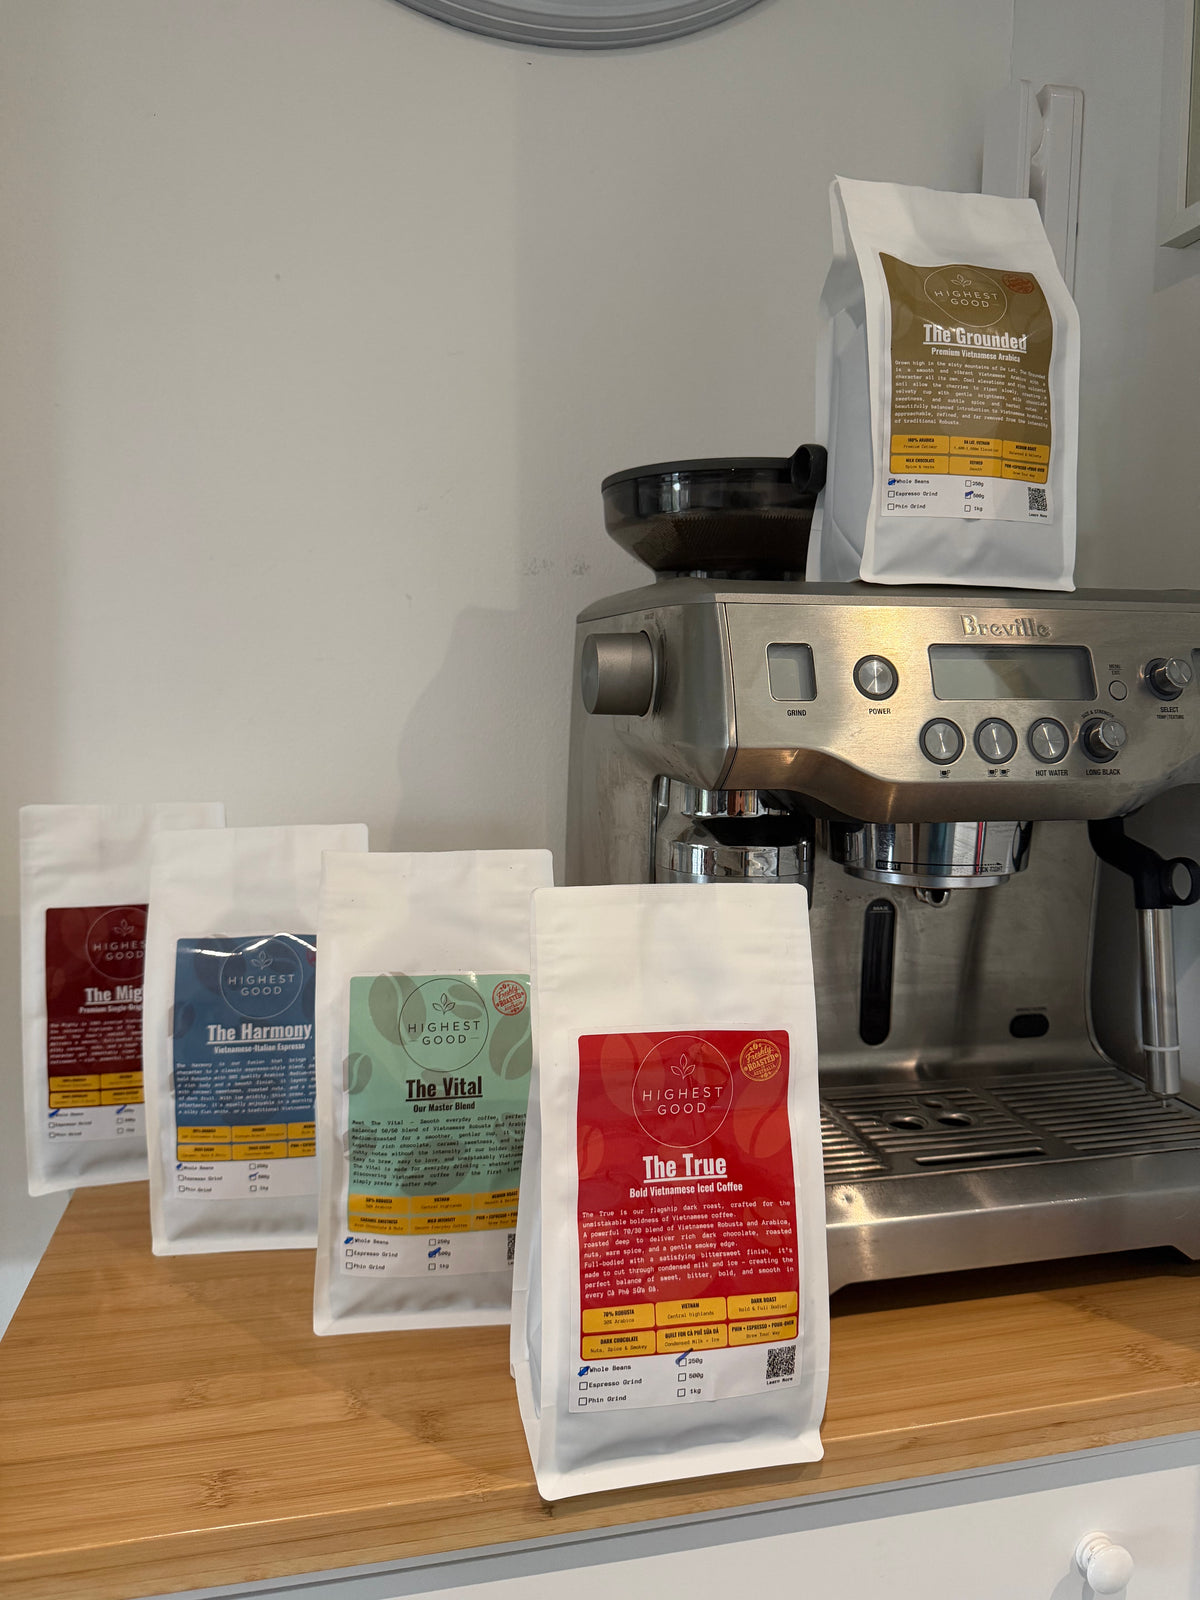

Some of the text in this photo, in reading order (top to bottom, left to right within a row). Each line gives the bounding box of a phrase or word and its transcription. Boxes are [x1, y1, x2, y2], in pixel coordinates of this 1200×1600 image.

[935, 290, 998, 300] HIGHEST
[951, 299, 990, 308] GOOD
[923, 324, 1027, 350] The Grounded
[931, 347, 1021, 363] Premium Vietnamese Arabica
[960, 614, 1051, 638] Breville
[877, 862, 899, 870] INSERT
[106, 951, 144, 961] GOOD
[228, 974, 295, 985] HIGHEST
[85, 988, 112, 1002] The
[241, 986, 282, 996] GOOD
[208, 1023, 312, 1041] The Harmony
[408, 1021, 481, 1033] HIGHEST
[423, 1034, 467, 1046] GOOD
[214, 1043, 306, 1054] Vietnamese-Italian Espresso
[746, 1045, 774, 1064] Freshly
[747, 1054, 776, 1072] ROASTED
[406, 1076, 483, 1099] The Vital
[643, 1087, 723, 1102] HIGHEST
[413, 1101, 476, 1113] Our Master Blend
[658, 1103, 706, 1115] GOOD
[643, 1153, 727, 1179] The True
[630, 1182, 743, 1198] Bold Vietnamese Iced Coffee
[651, 1206, 678, 1214] flagship
[582, 1219, 627, 1229] unmistakable
[591, 1230, 619, 1238] powerful
[584, 1240, 610, 1248] roasted
[670, 1243, 692, 1252] gentle
[701, 1250, 741, 1258] bittersweet
[584, 1259, 624, 1269] Full-bodied
[629, 1266, 654, 1274] through
[658, 1263, 691, 1271] condensed
[585, 1278, 642, 1289] perfect balance
[615, 1309, 635, 1317] ROBUSTA
[614, 1336, 638, 1344] CHOCOLATE
[589, 1381, 620, 1389] Espresso
